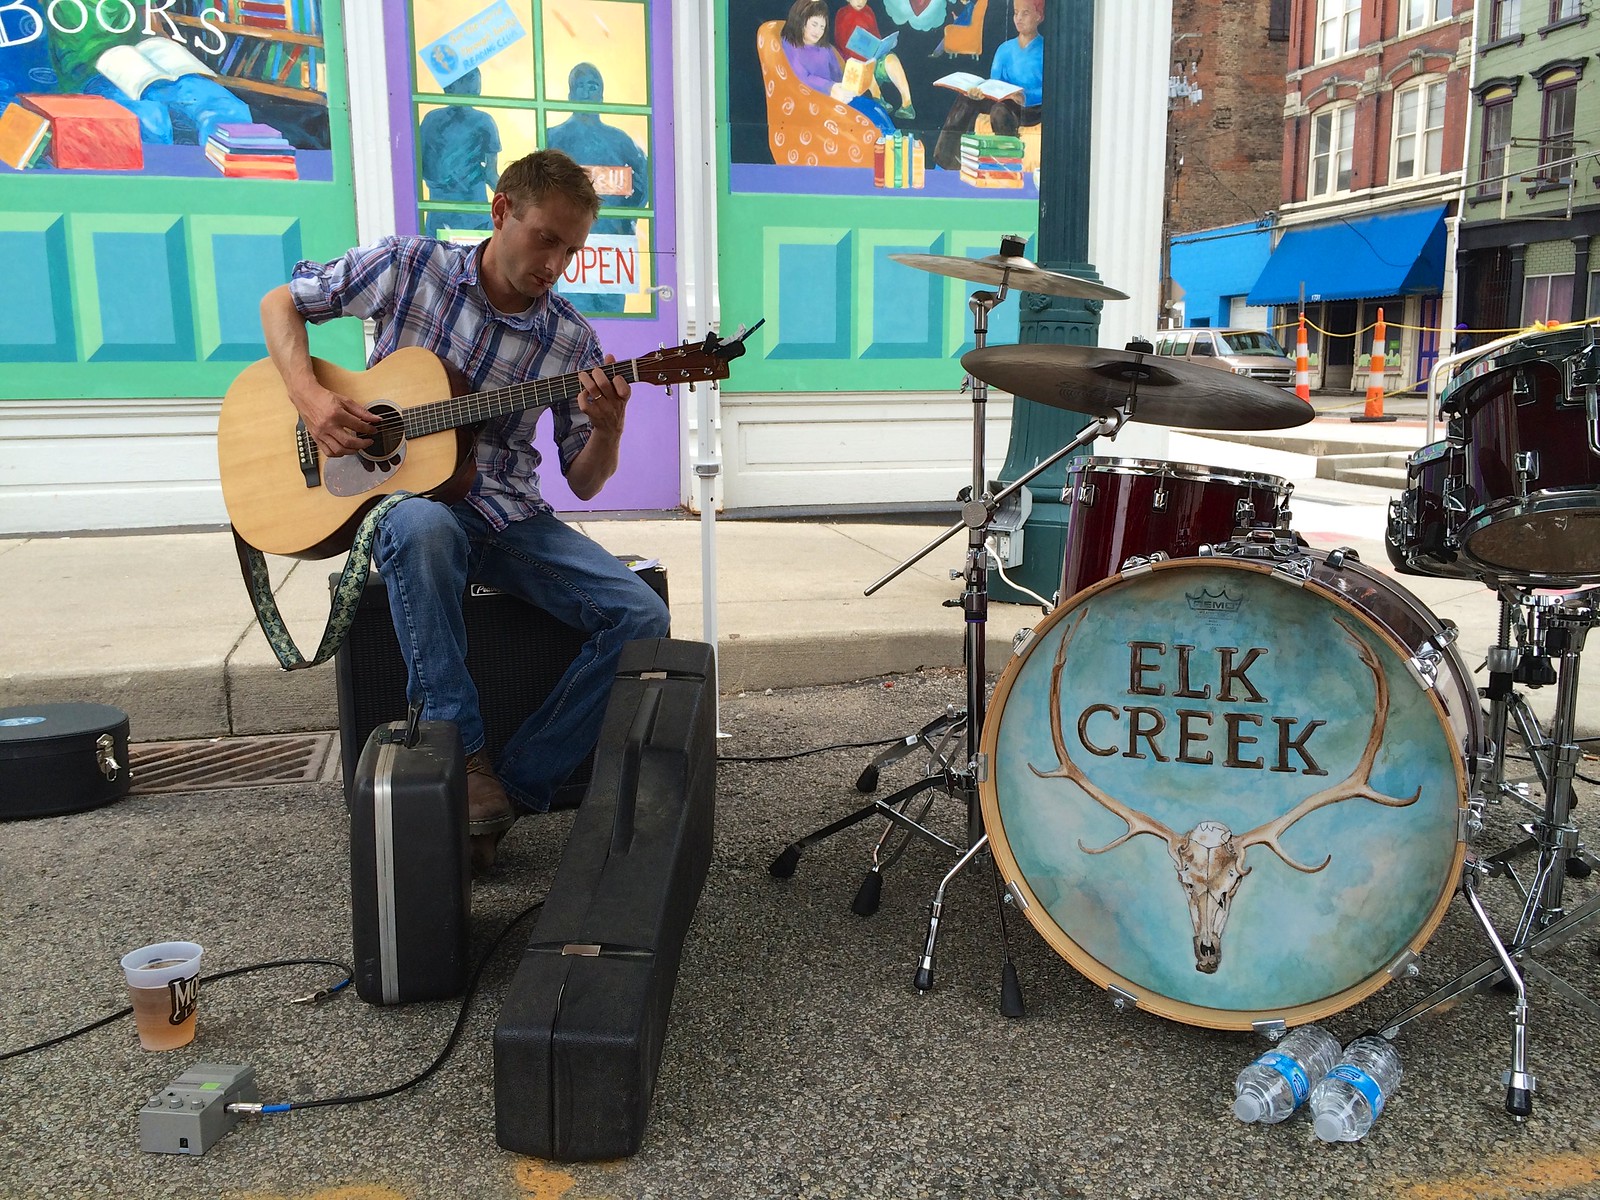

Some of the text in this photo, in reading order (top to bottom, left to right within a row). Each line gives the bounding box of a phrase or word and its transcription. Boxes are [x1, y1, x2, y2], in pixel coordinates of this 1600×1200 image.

[0, 0, 226, 55] BOOKS
[463, 43, 496, 70] READING
[563, 246, 634, 285] OPEN
[1193, 600, 1235, 610] REMO
[1126, 640, 1269, 703] ELK
[1077, 703, 1329, 777] CREEK
